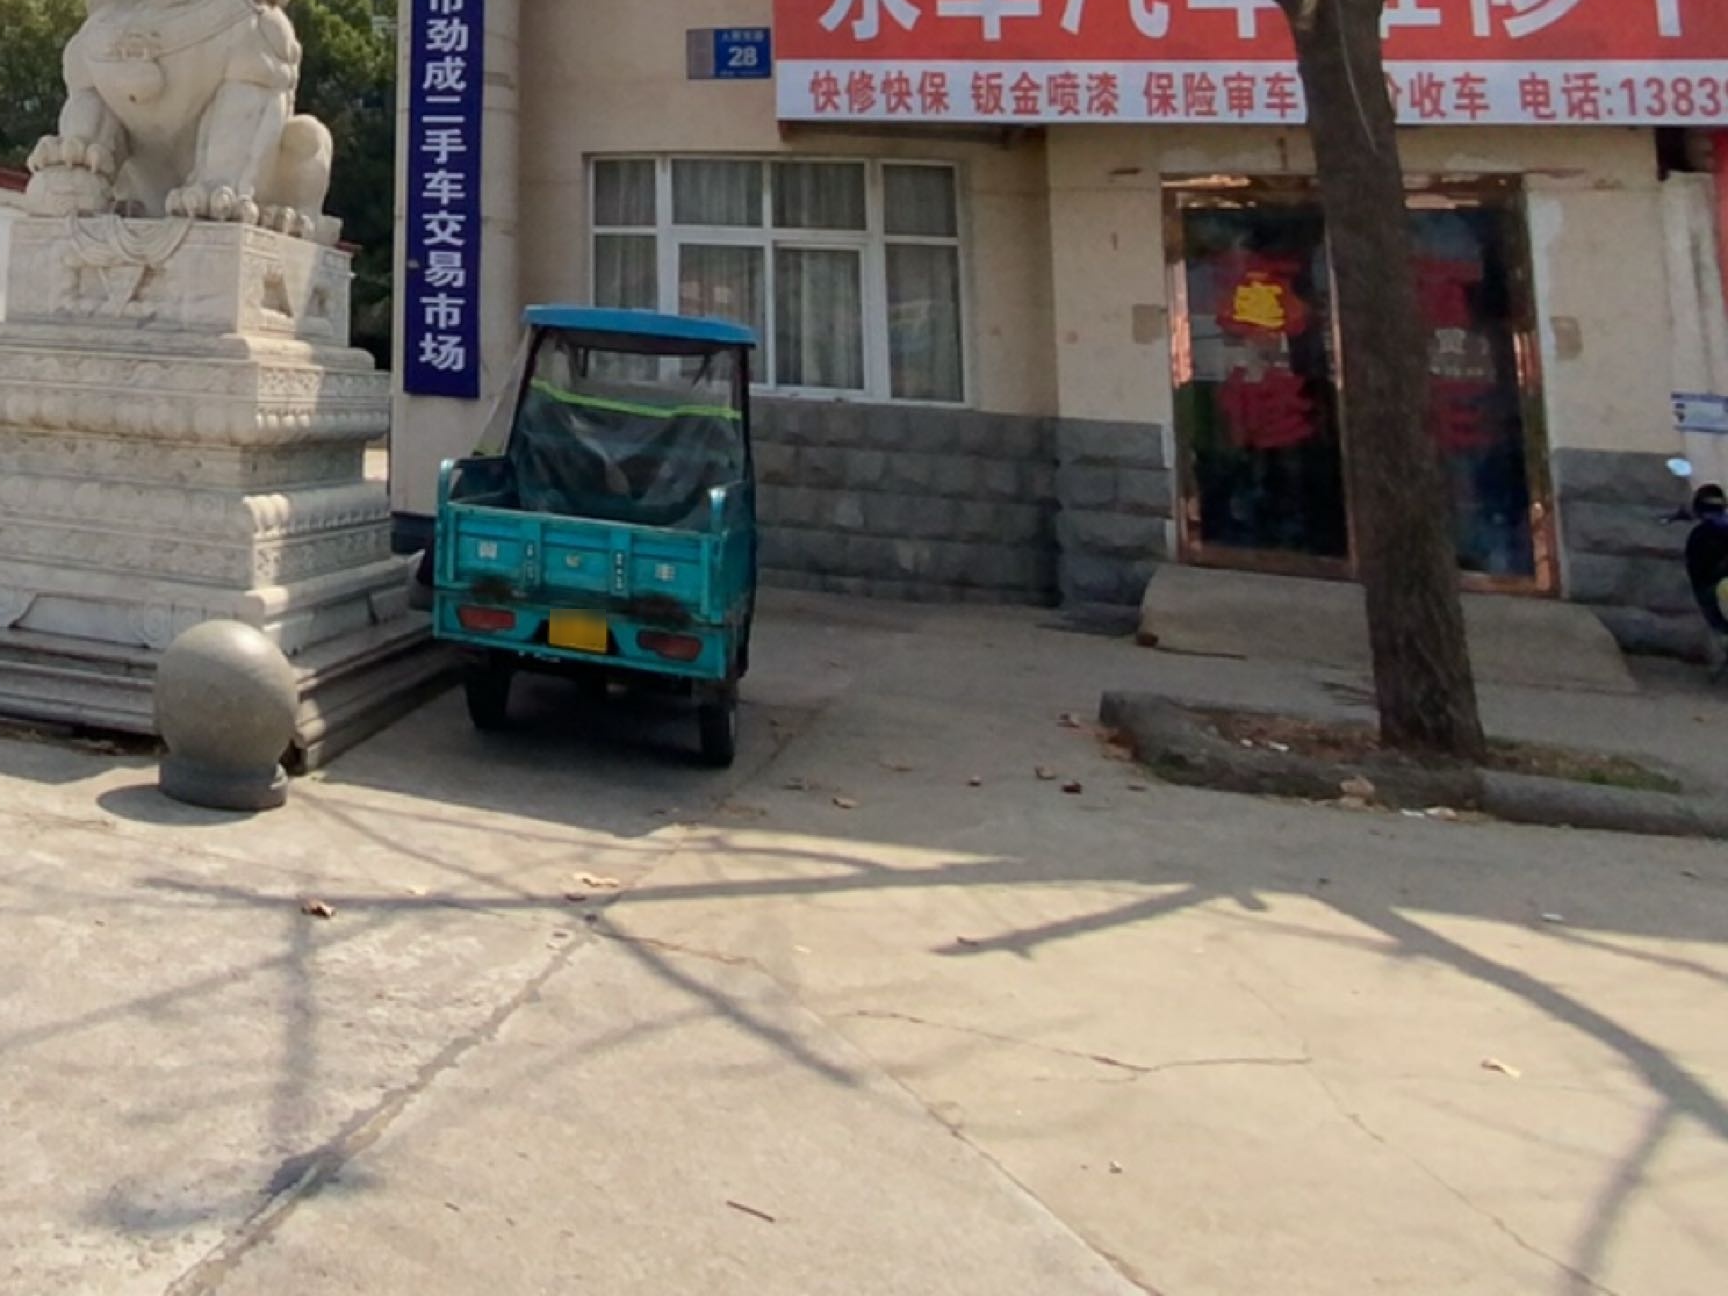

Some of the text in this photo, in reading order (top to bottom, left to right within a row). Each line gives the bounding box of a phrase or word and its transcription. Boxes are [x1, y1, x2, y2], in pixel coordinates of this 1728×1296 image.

[728, 46, 758, 66] 28
[809, 71, 951, 115] 快修快保
[970, 71, 1120, 117] 钣金喷漆
[1143, 71, 1298, 119] 保险审车
[1519, 72, 1728, 121] 电话:1383
